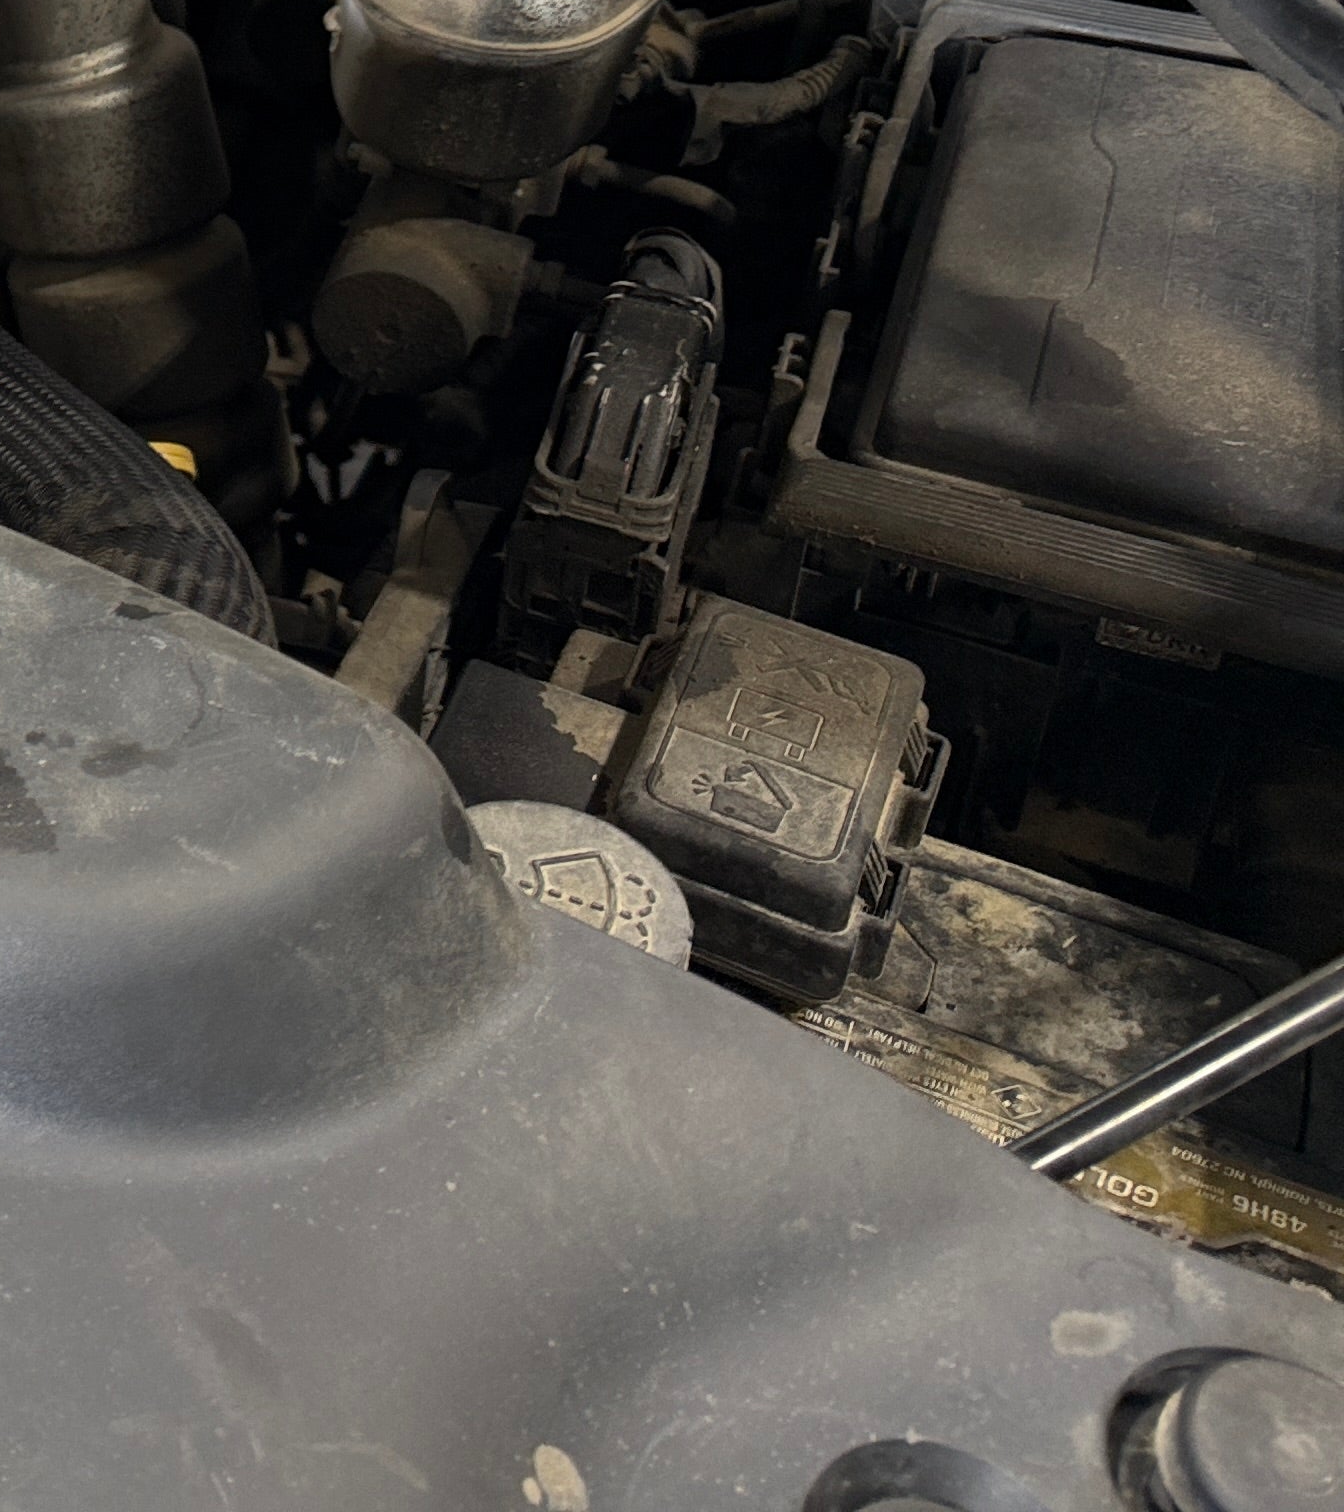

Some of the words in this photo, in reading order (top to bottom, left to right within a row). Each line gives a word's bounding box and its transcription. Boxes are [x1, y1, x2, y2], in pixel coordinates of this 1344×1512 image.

[1171, 1144, 1222, 1172] 27604
[1223, 1165, 1247, 1181] NC
[1232, 1194, 1308, 1233] 48H6
[1314, 1197, 1344, 1218] arts,
